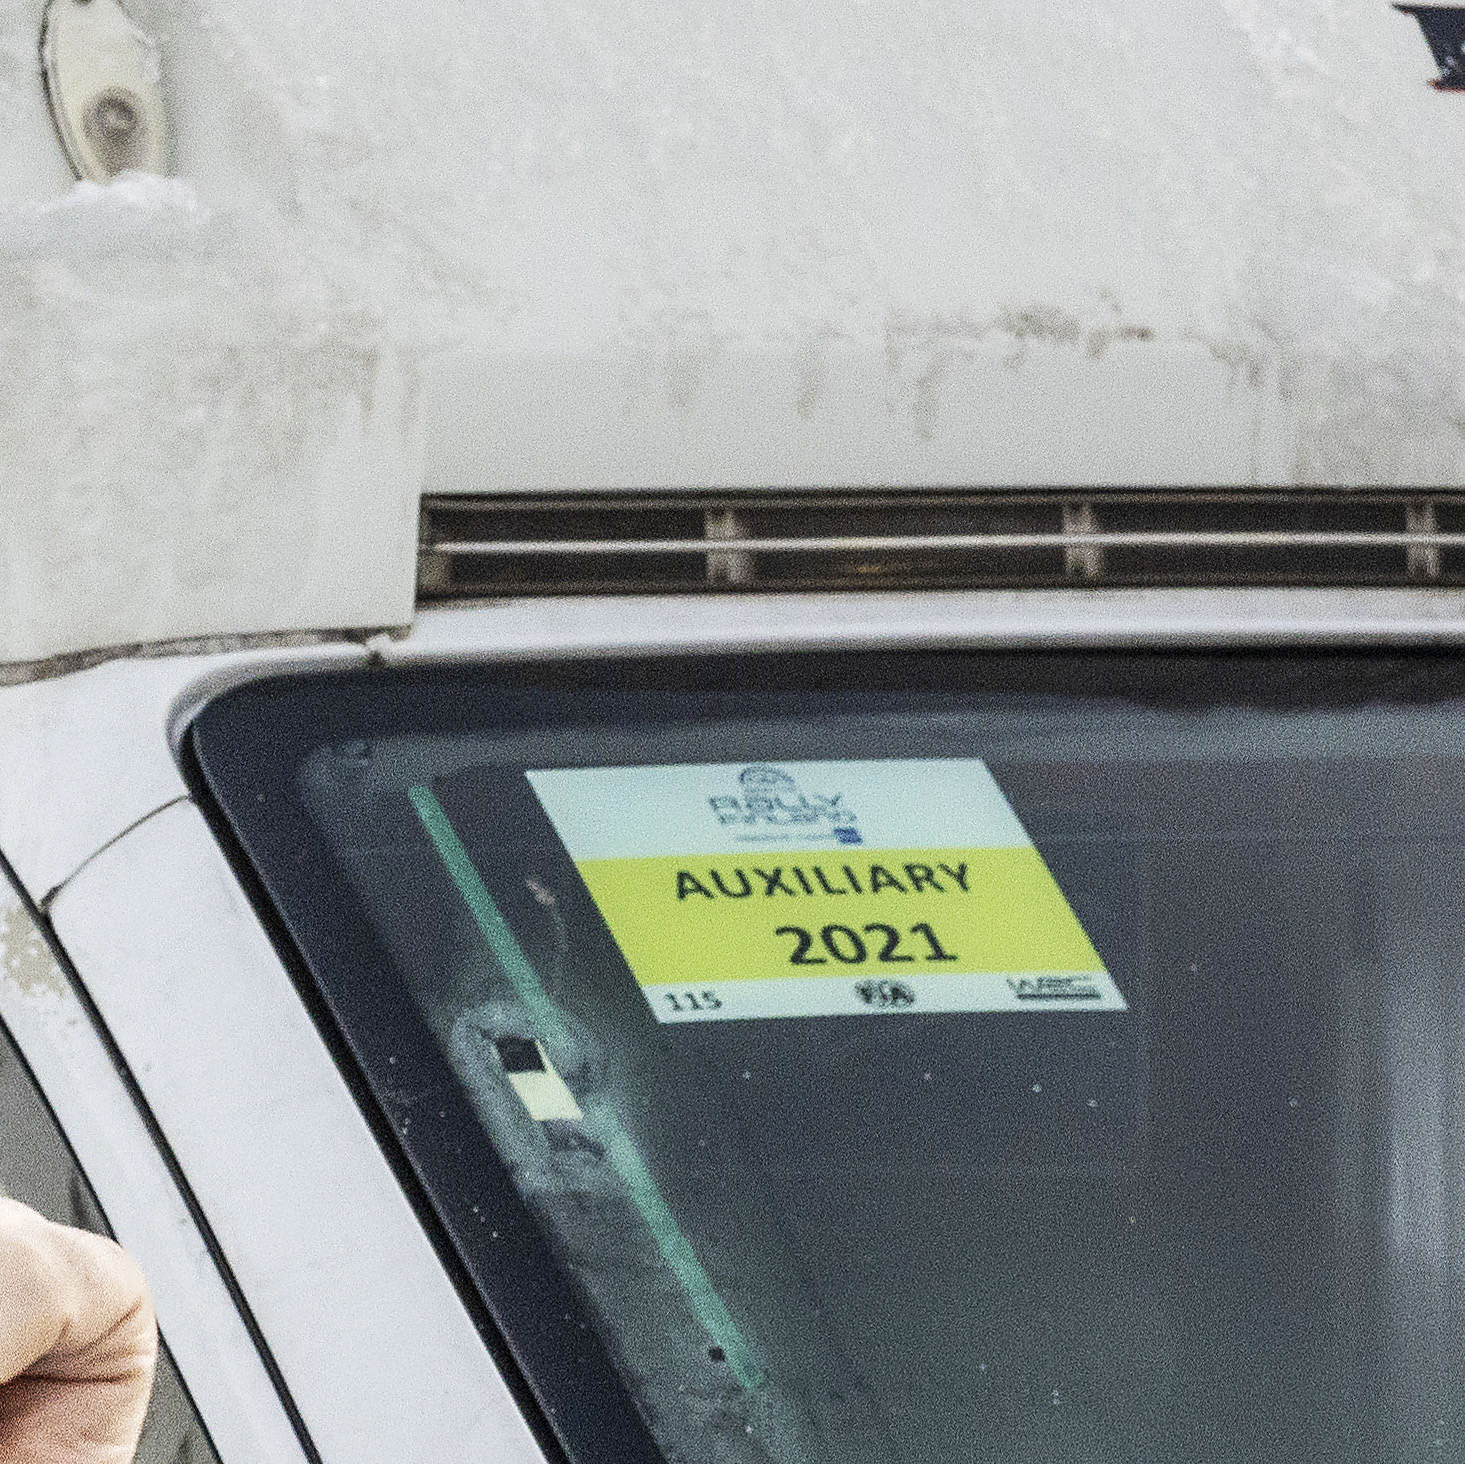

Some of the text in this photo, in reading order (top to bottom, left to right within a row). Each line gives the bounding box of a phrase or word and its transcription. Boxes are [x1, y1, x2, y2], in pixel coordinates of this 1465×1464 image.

[676, 863, 970, 899] AUXILIARY
[774, 922, 958, 965] 2021
[664, 990, 722, 1011] 115
